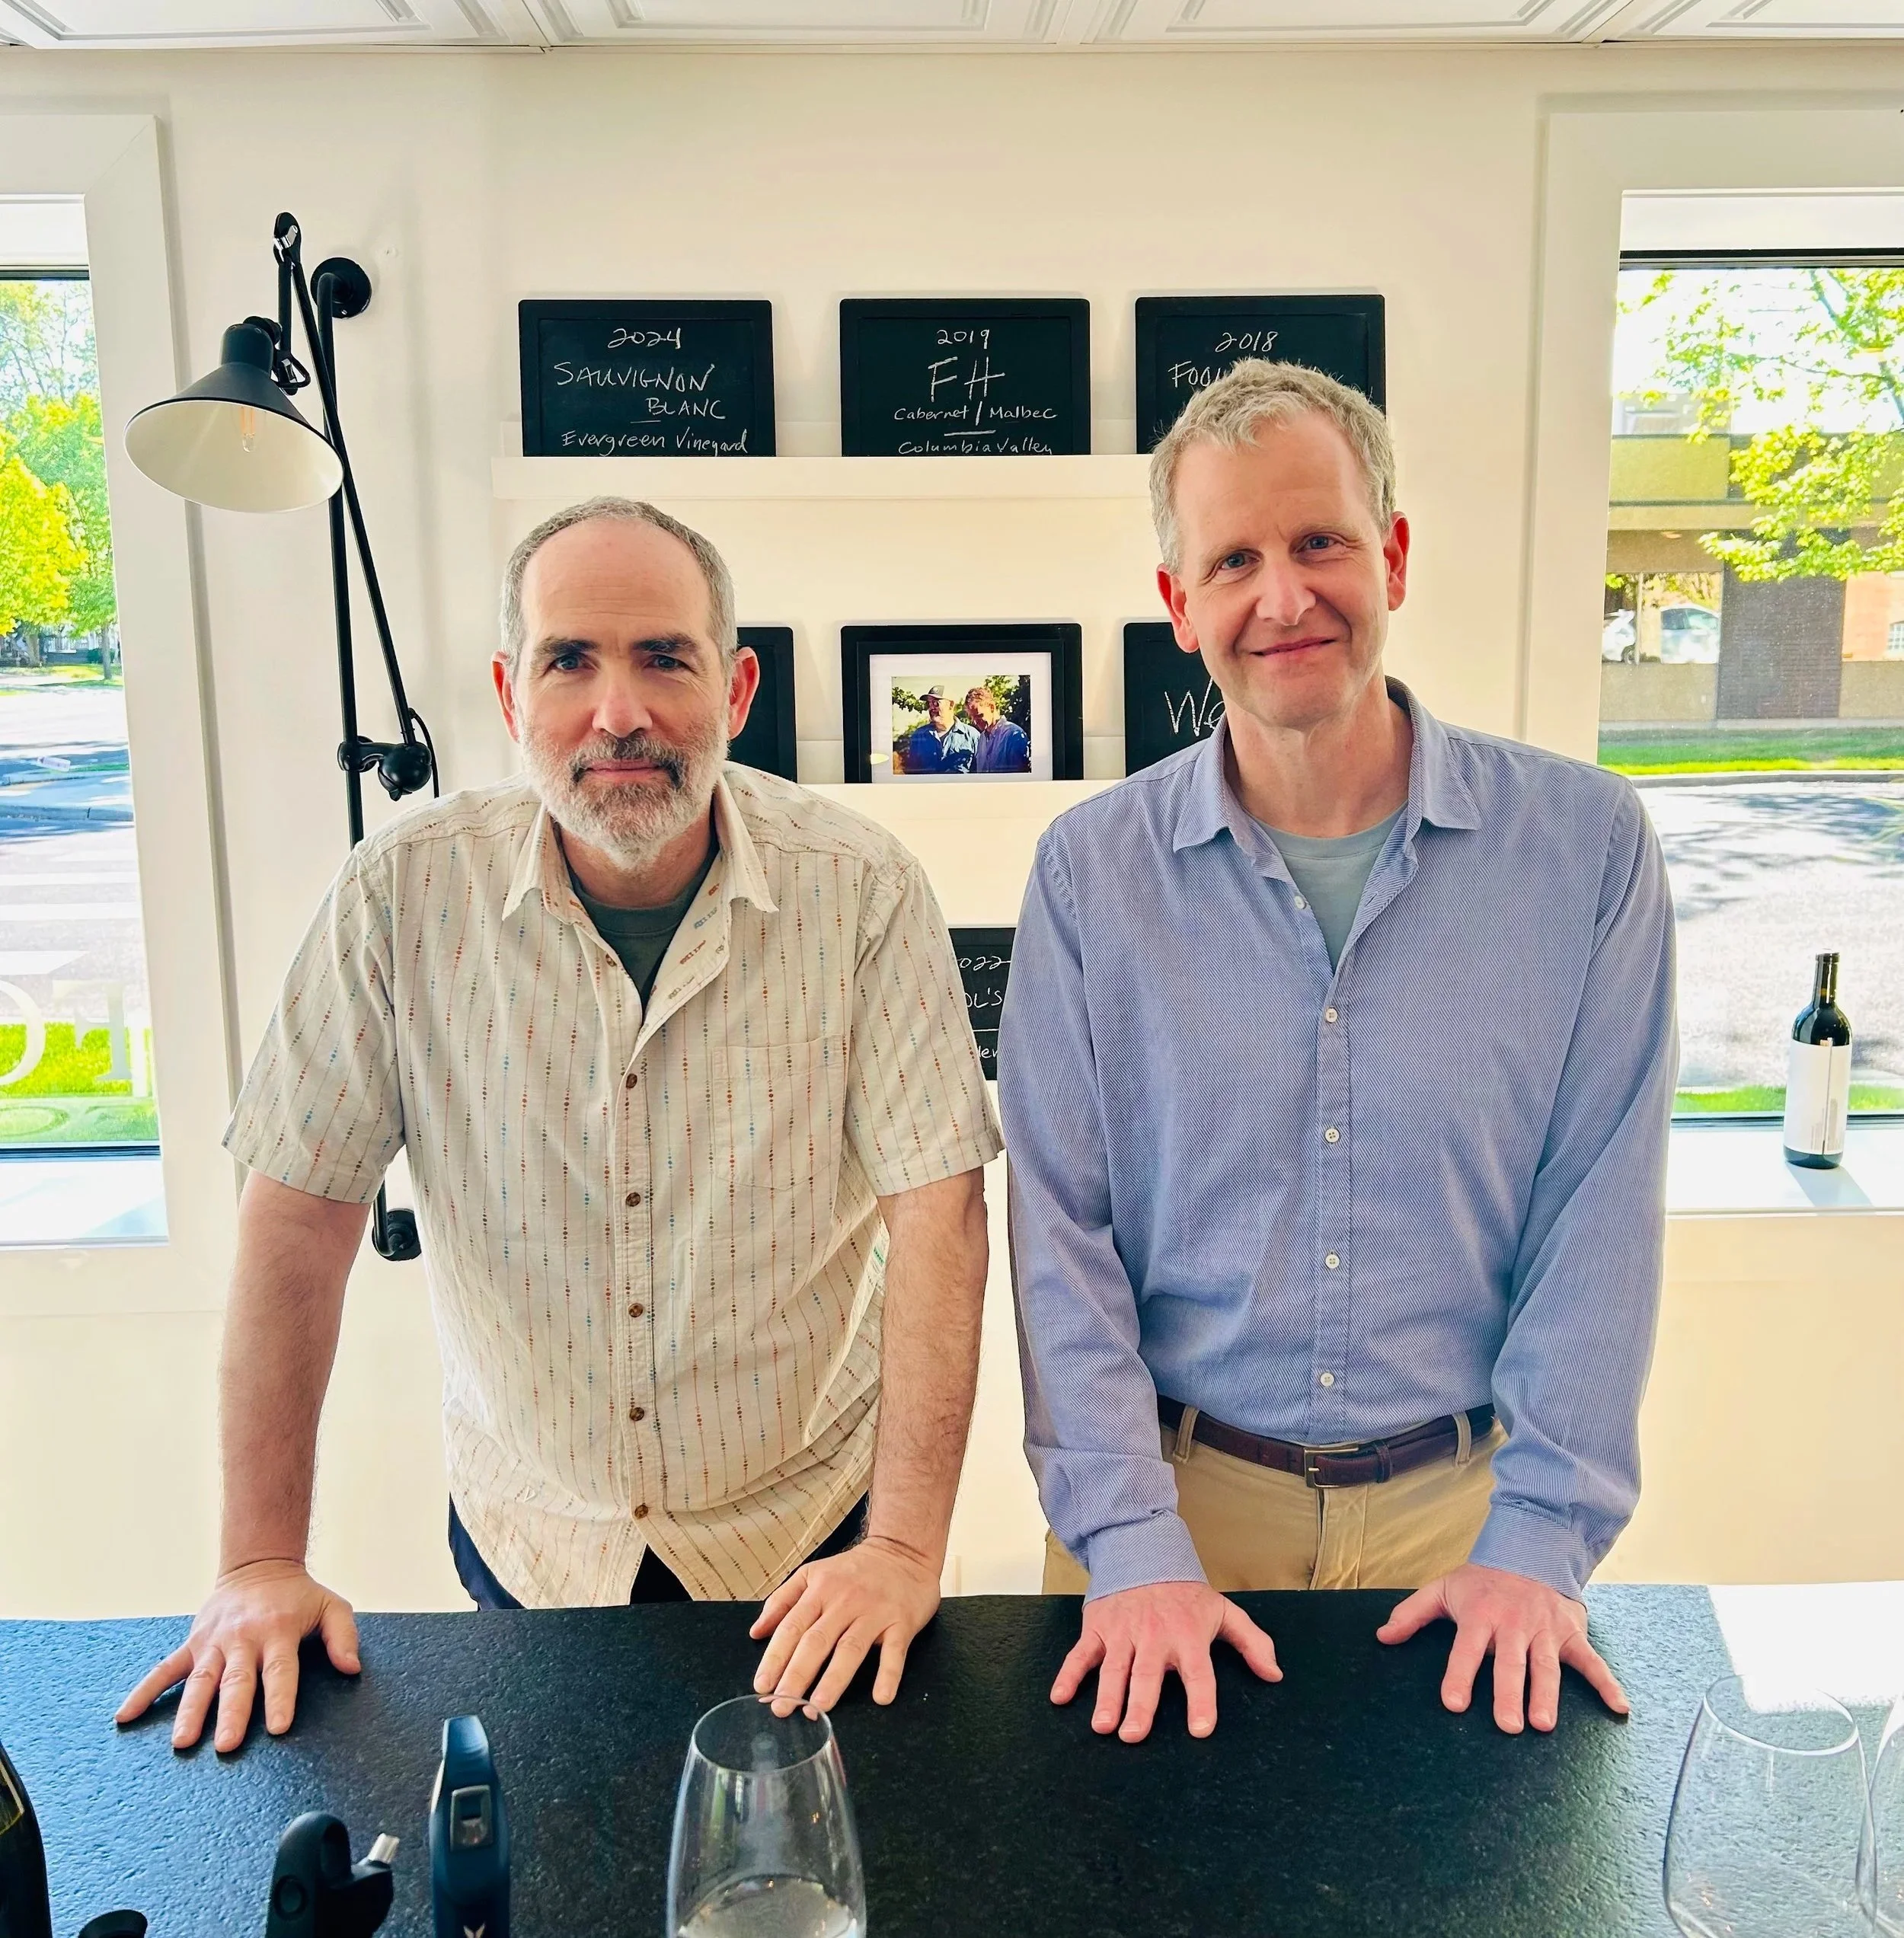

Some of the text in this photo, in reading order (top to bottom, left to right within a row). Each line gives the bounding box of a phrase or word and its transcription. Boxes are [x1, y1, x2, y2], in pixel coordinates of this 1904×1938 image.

[608, 328, 681, 349] 2024
[938, 330, 989, 349] 2019
[1216, 331, 1278, 352] 2018
[554, 362, 714, 391] SAUVIGNON
[646, 397, 725, 419] BLANC
[895, 405, 969, 420] Cabernet
[561, 426, 747, 457] Evergreen Vineyard
[899, 440, 991, 454] Columbia
[957, 956, 1011, 971] 022
